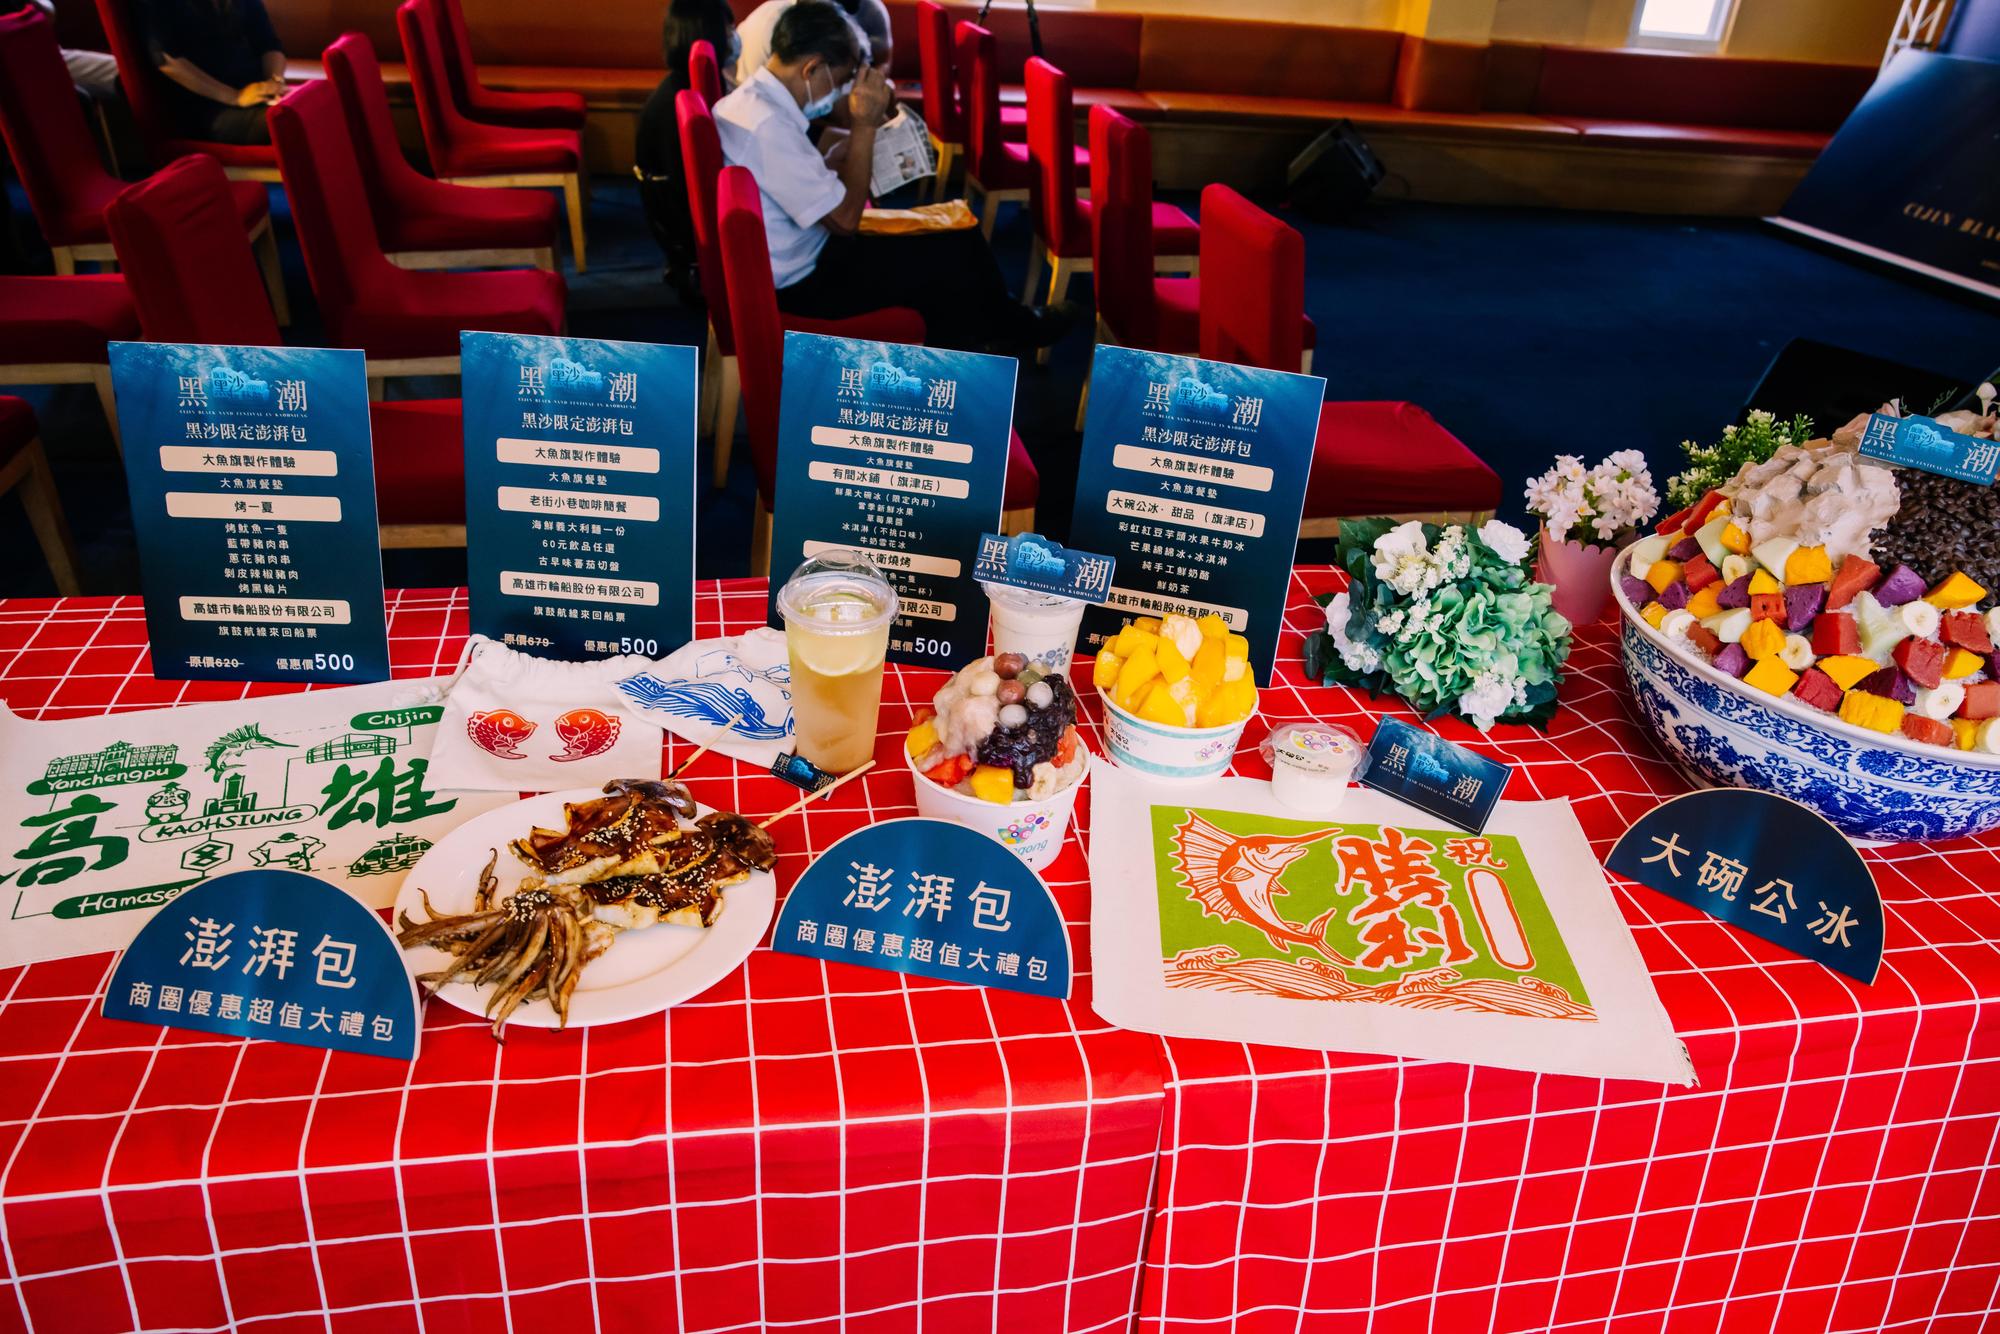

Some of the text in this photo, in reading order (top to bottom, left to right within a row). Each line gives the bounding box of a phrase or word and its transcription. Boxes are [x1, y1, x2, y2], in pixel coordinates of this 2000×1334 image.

[178, 375, 307, 411] 黑 潮
[518, 364, 637, 403] 黑 潮
[837, 366, 957, 410] 黑 潮
[1143, 381, 1264, 427] 黑 潮
[186, 422, 307, 442] 黑沙限定澎湃包
[522, 412, 634, 435] 黑沙限定澎湃包
[838, 408, 949, 436] 黑沙限定澎湃包
[849, 433, 935, 456] 大魚旗製作體驗
[1141, 425, 1251, 457] 黑沙限定澎湃包
[1864, 417, 2000, 475] 黑 潮
[202, 453, 296, 469] 大魚旗製作體驗
[535, 447, 621, 464] 大魚旗製作體驗
[1150, 455, 1235, 480] 大魚旗製作體驗
[220, 478, 284, 490] 大魚旗餐墊
[549, 472, 608, 486] 大魚旗餐墊
[1160, 480, 1218, 500] 大魚旗餐墊
[234, 500, 274, 514] 烤一夏
[530, 495, 627, 514] 老街小巷咖啡簡餐
[542, 539, 615, 554] 60元飲品任選
[1118, 521, 1245, 552] 彩虹紅豆芋頭水果牛奶冰
[976, 538, 1110, 592] 黑 潮
[239, 583, 287, 594] 烤黑輪片
[512, 577, 644, 598] 高雄市輪船股份有限公司
[1156, 580, 1191, 595] 鮮奶茶
[193, 602, 335, 618] 高雄市輪船股份有限公司
[533, 605, 626, 622] 旗鼓航線來回船票
[218, 625, 317, 639] 旗鼓航線來回船票
[887, 636, 952, 657] 惠價500
[368, 711, 432, 727] Chijin
[47, 766, 170, 792] Yanchengpu
[1382, 742, 1483, 803] 黑 潮
[155, 808, 303, 839] KAOHSIUNG
[1443, 837, 1509, 869] 祝
[842, 860, 1012, 932] 澎湃包
[1334, 825, 1475, 970] 勝利
[1640, 832, 1859, 948] 大碗公冰
[178, 916, 357, 989] 澎湃包
[797, 920, 1048, 982] 商圈優惠超值大禮包
[129, 981, 394, 1042] 商圈優惠超值大禮包
